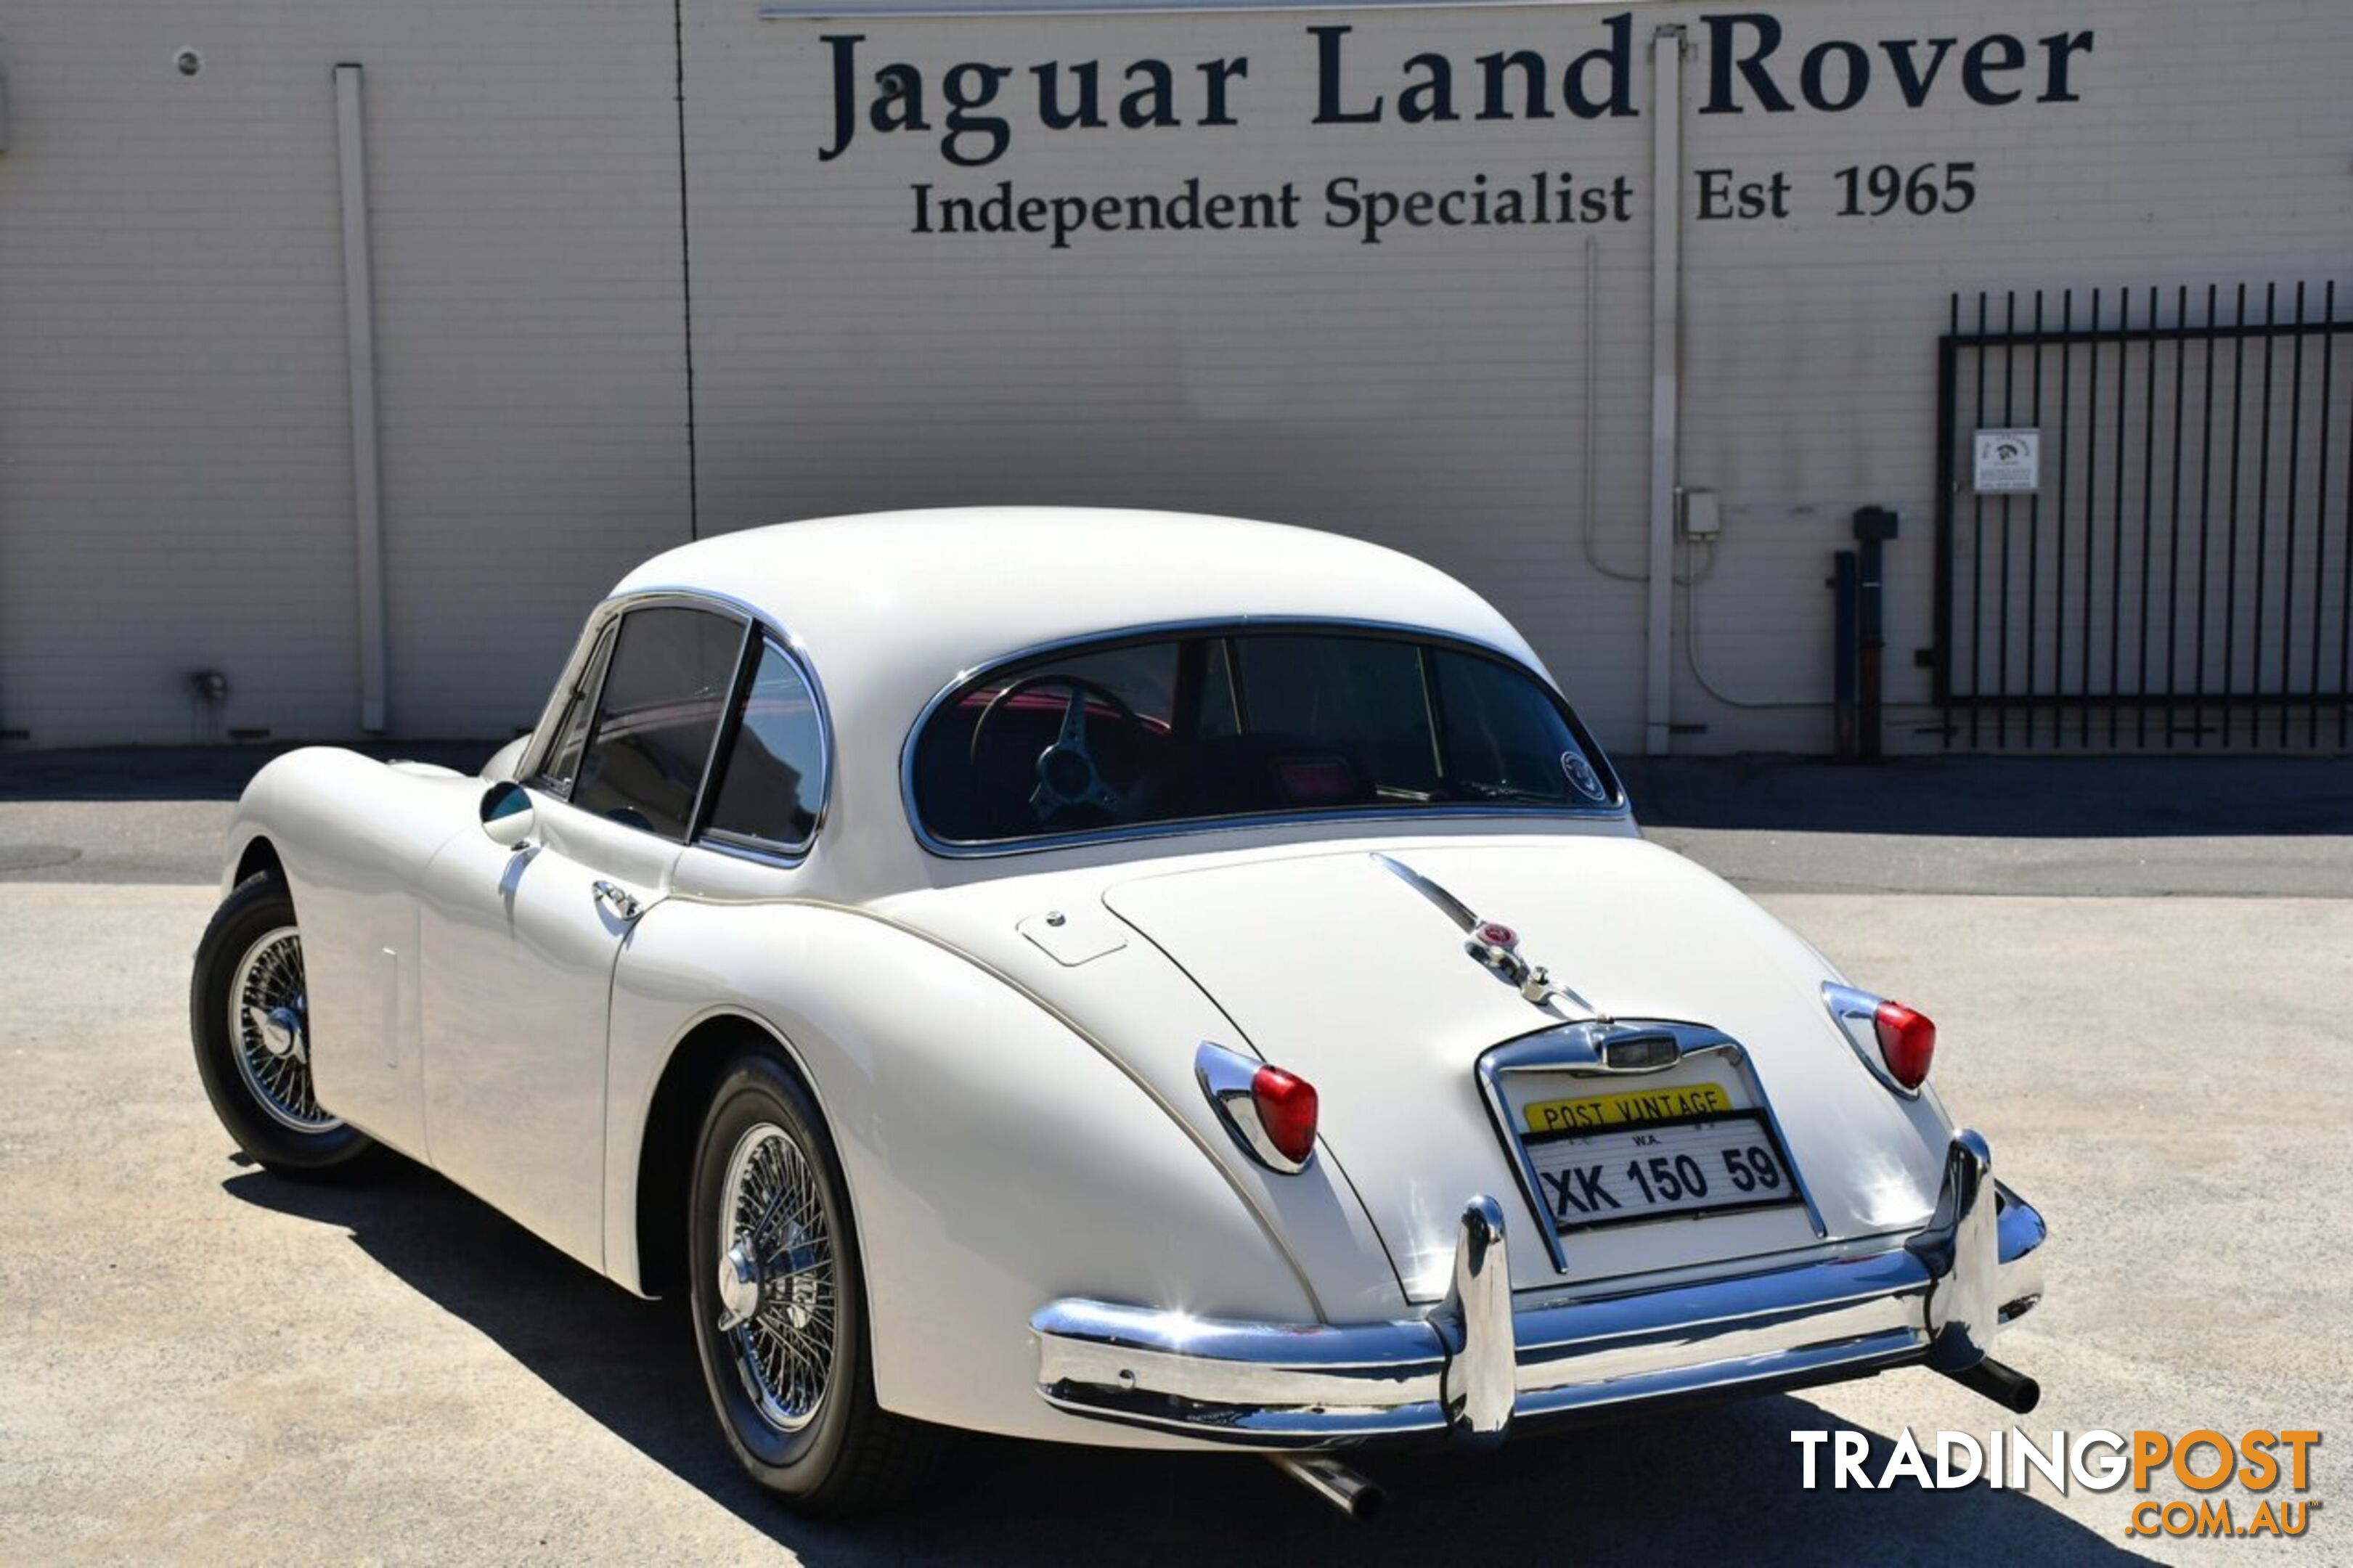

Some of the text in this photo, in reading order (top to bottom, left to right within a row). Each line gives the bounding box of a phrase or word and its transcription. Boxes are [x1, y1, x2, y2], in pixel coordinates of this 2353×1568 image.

[818, 12, 2095, 167] Jaguar Land Rover
[910, 161, 1976, 249] Independent Specialist Est 1965
[1543, 1090, 1718, 1130] POST VINTAGE
[1541, 1146, 1782, 1217] XK 150 59
